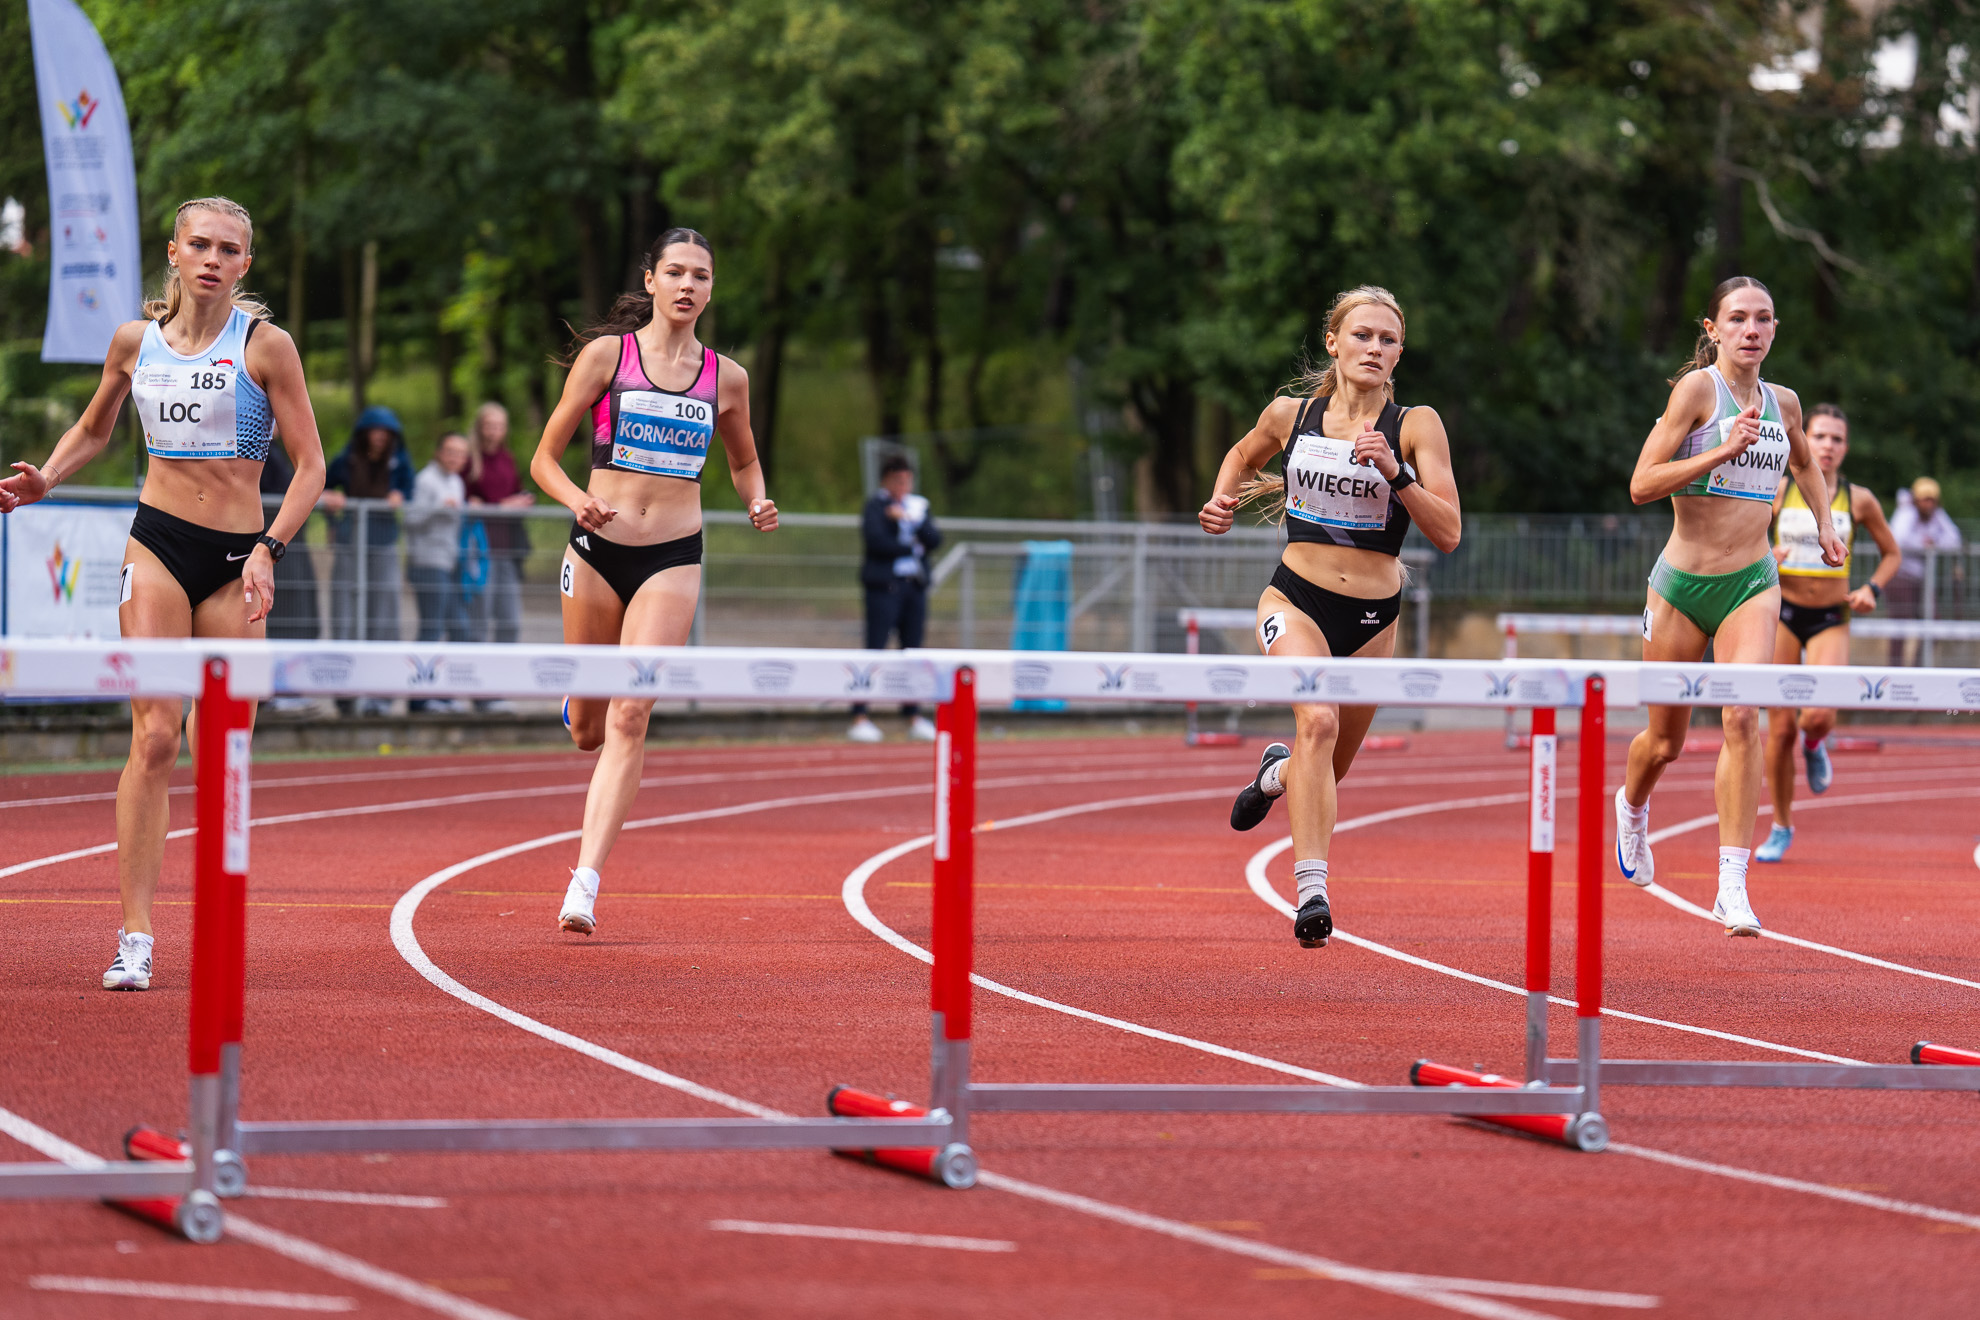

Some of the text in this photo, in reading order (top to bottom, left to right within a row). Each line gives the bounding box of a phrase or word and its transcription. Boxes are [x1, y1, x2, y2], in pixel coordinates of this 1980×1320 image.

[191, 372, 226, 390] 185
[160, 402, 202, 423] LOC
[675, 402, 706, 420] 100
[619, 420, 706, 449] KORNACKA
[1760, 426, 1784, 442] 446
[1296, 468, 1380, 499] WIĘCEK
[563, 564, 571, 592] 6
[1263, 615, 1279, 645] 5
